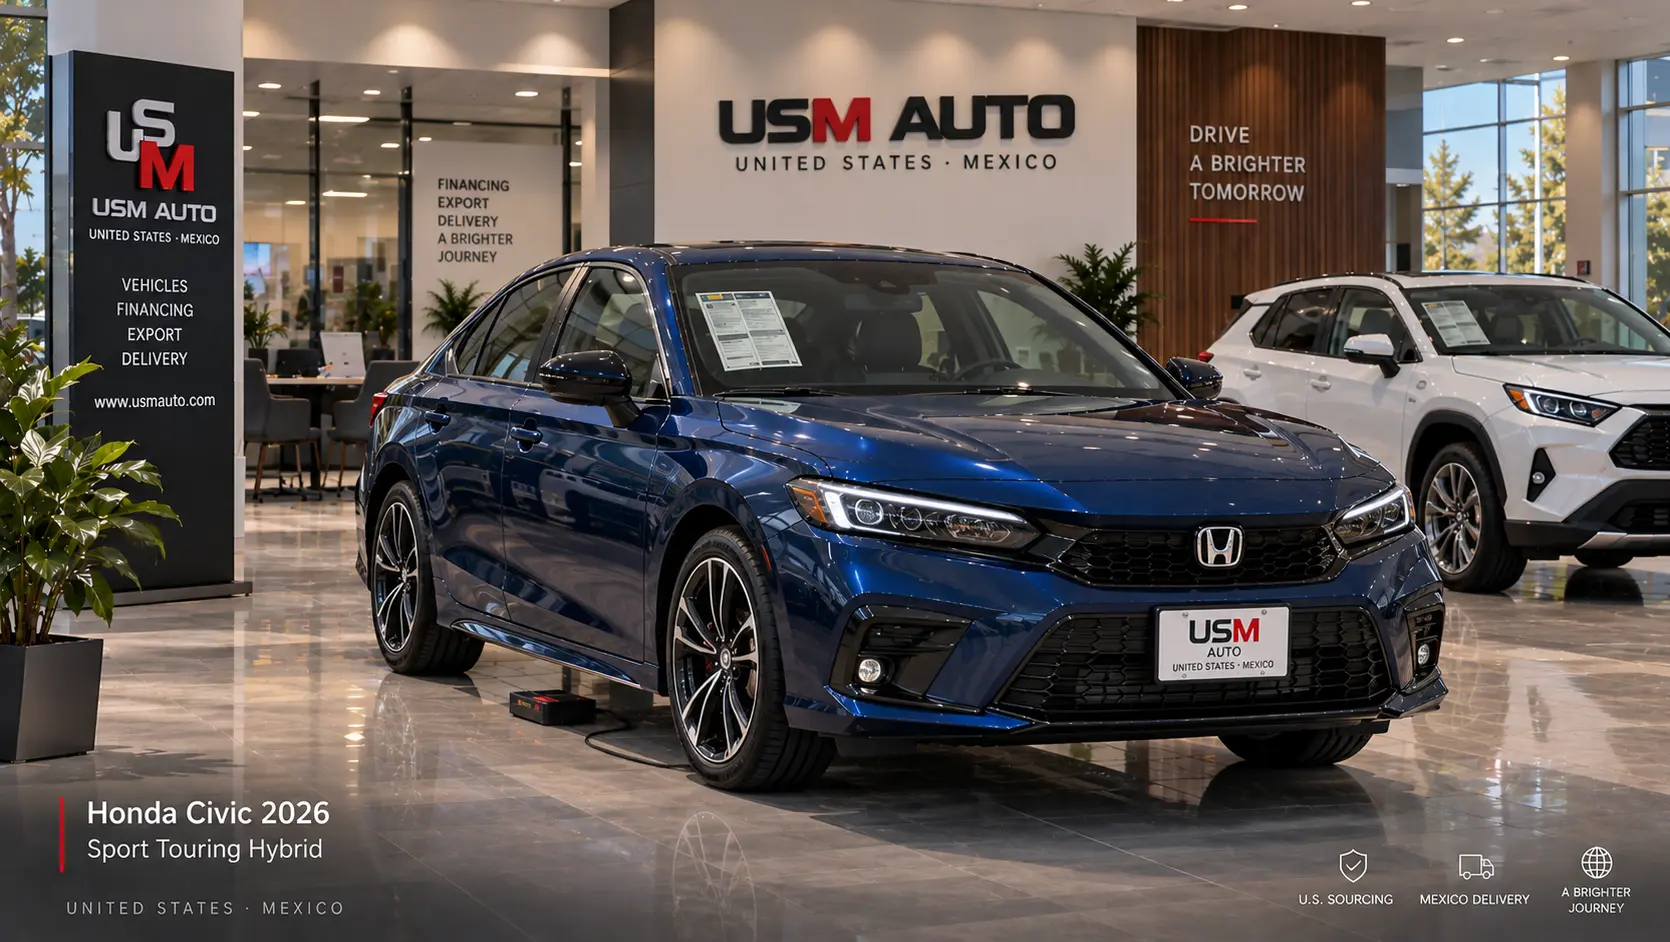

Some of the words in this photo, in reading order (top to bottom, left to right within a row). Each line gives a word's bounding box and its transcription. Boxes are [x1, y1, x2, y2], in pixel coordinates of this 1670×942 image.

[718, 97, 872, 146] USM
[888, 94, 1076, 143] AUTO
[1190, 125, 1250, 144] DRIVE
[735, 155, 826, 172] UNITED
[842, 154, 932, 171] STATES
[963, 153, 1057, 170] MEXICO
[1189, 154, 1203, 172] A
[1211, 154, 1306, 173] BRIGHTER
[437, 177, 510, 192] FINANCING
[1189, 182, 1305, 202] TOMORROW
[437, 195, 490, 209] EXPORT
[92, 197, 147, 219] USM
[154, 202, 217, 223] AUTO
[437, 214, 499, 228] DELIVERY
[89, 228, 130, 241] UNITED
[133, 230, 172, 243] STATES
[180, 233, 220, 245] MEXICO
[437, 232, 447, 245] A
[450, 232, 513, 246] BRIGHTER
[437, 250, 498, 263] JOURNEY
[121, 277, 188, 293] VEHICLES
[117, 302, 194, 318] FINANCING
[127, 327, 183, 342] EXPORT
[122, 351, 188, 366] DELIVERY
[94, 394, 216, 409] www.usmauto.com
[1189, 617, 1260, 644] USM
[1206, 645, 1242, 658] AUTO
[1172, 662, 1204, 673] UNITED
[1205, 661, 1236, 671] STATES
[1242, 659, 1275, 669] MEXICO
